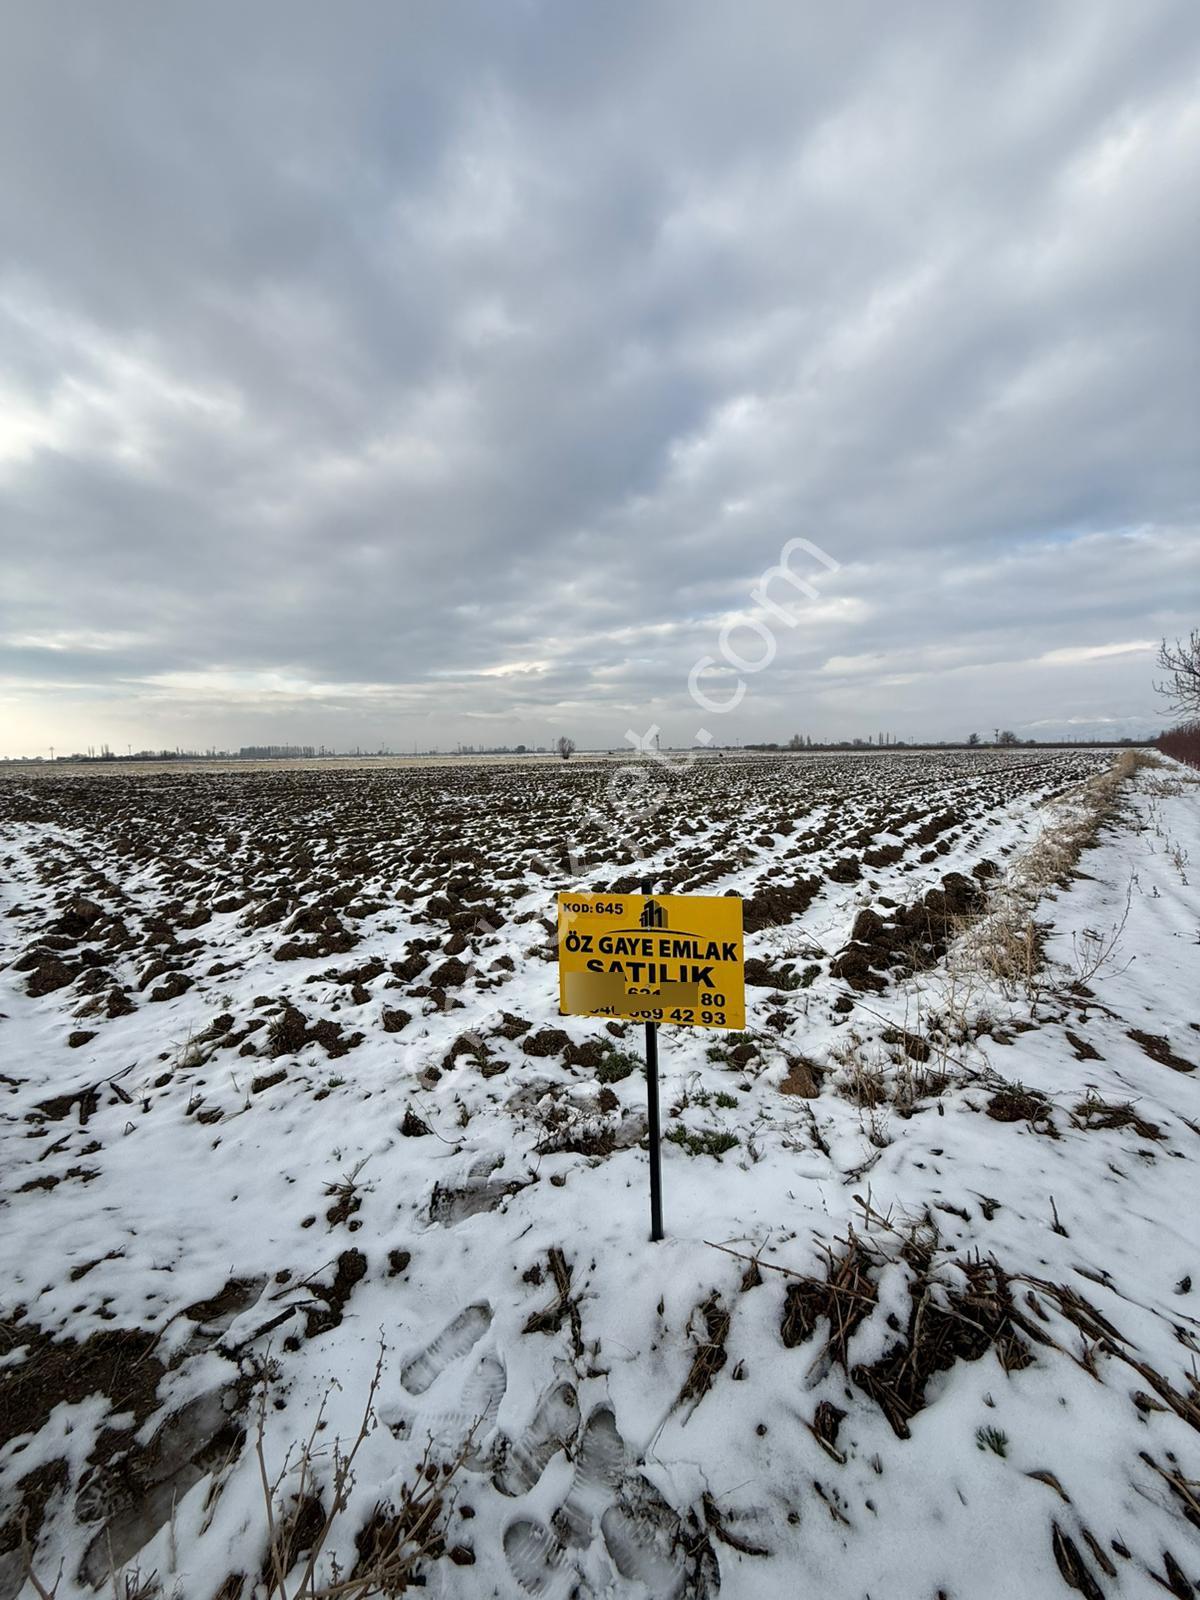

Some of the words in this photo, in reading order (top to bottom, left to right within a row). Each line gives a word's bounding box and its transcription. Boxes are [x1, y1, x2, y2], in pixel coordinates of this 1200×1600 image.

[563, 902, 593, 914] KOD:
[595, 902, 624, 915] 645
[565, 931, 594, 953] ÖZ
[599, 936, 653, 956] GAYE
[659, 939, 738, 962] EMLAK
[701, 993, 726, 1008] 80
[670, 1008, 695, 1023] 42
[701, 1010, 727, 1025] 93
